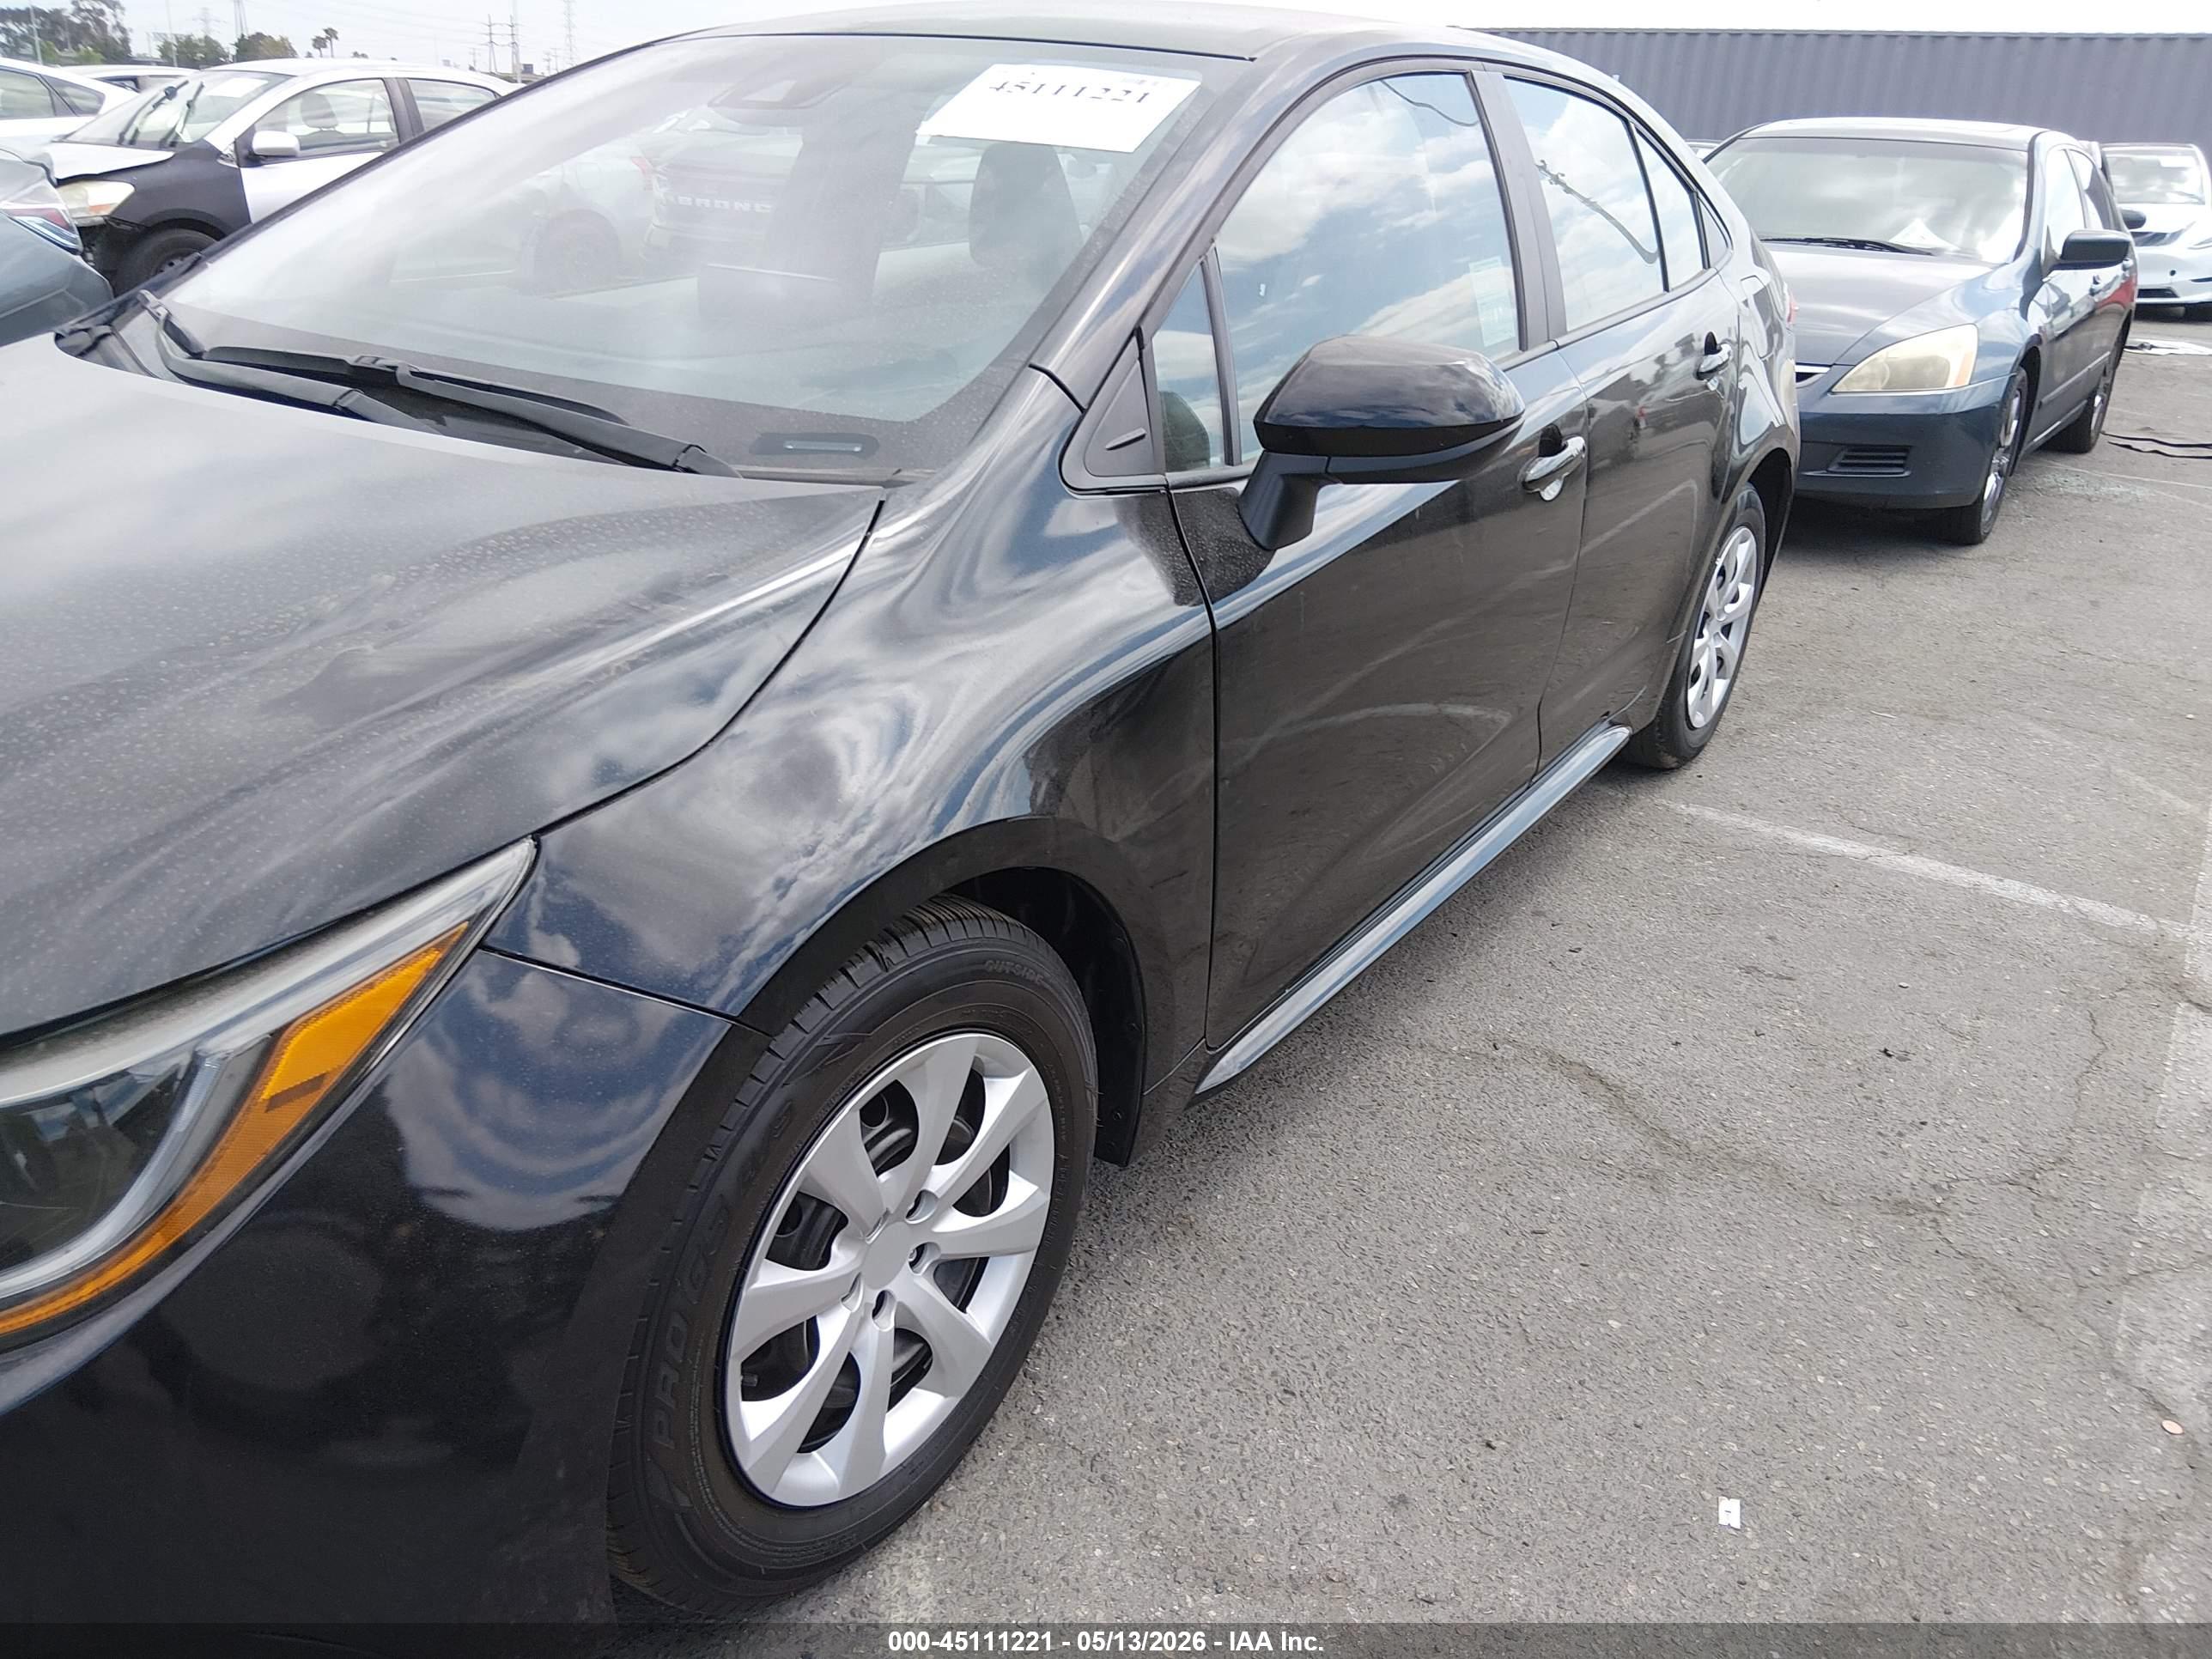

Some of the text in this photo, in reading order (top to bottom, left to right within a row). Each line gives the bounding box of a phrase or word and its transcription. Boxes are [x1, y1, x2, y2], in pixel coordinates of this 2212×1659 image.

[988, 80, 1150, 104] 45111221
[677, 186, 773, 213] BRONC
[984, 959, 1045, 984] OUTSIDE
